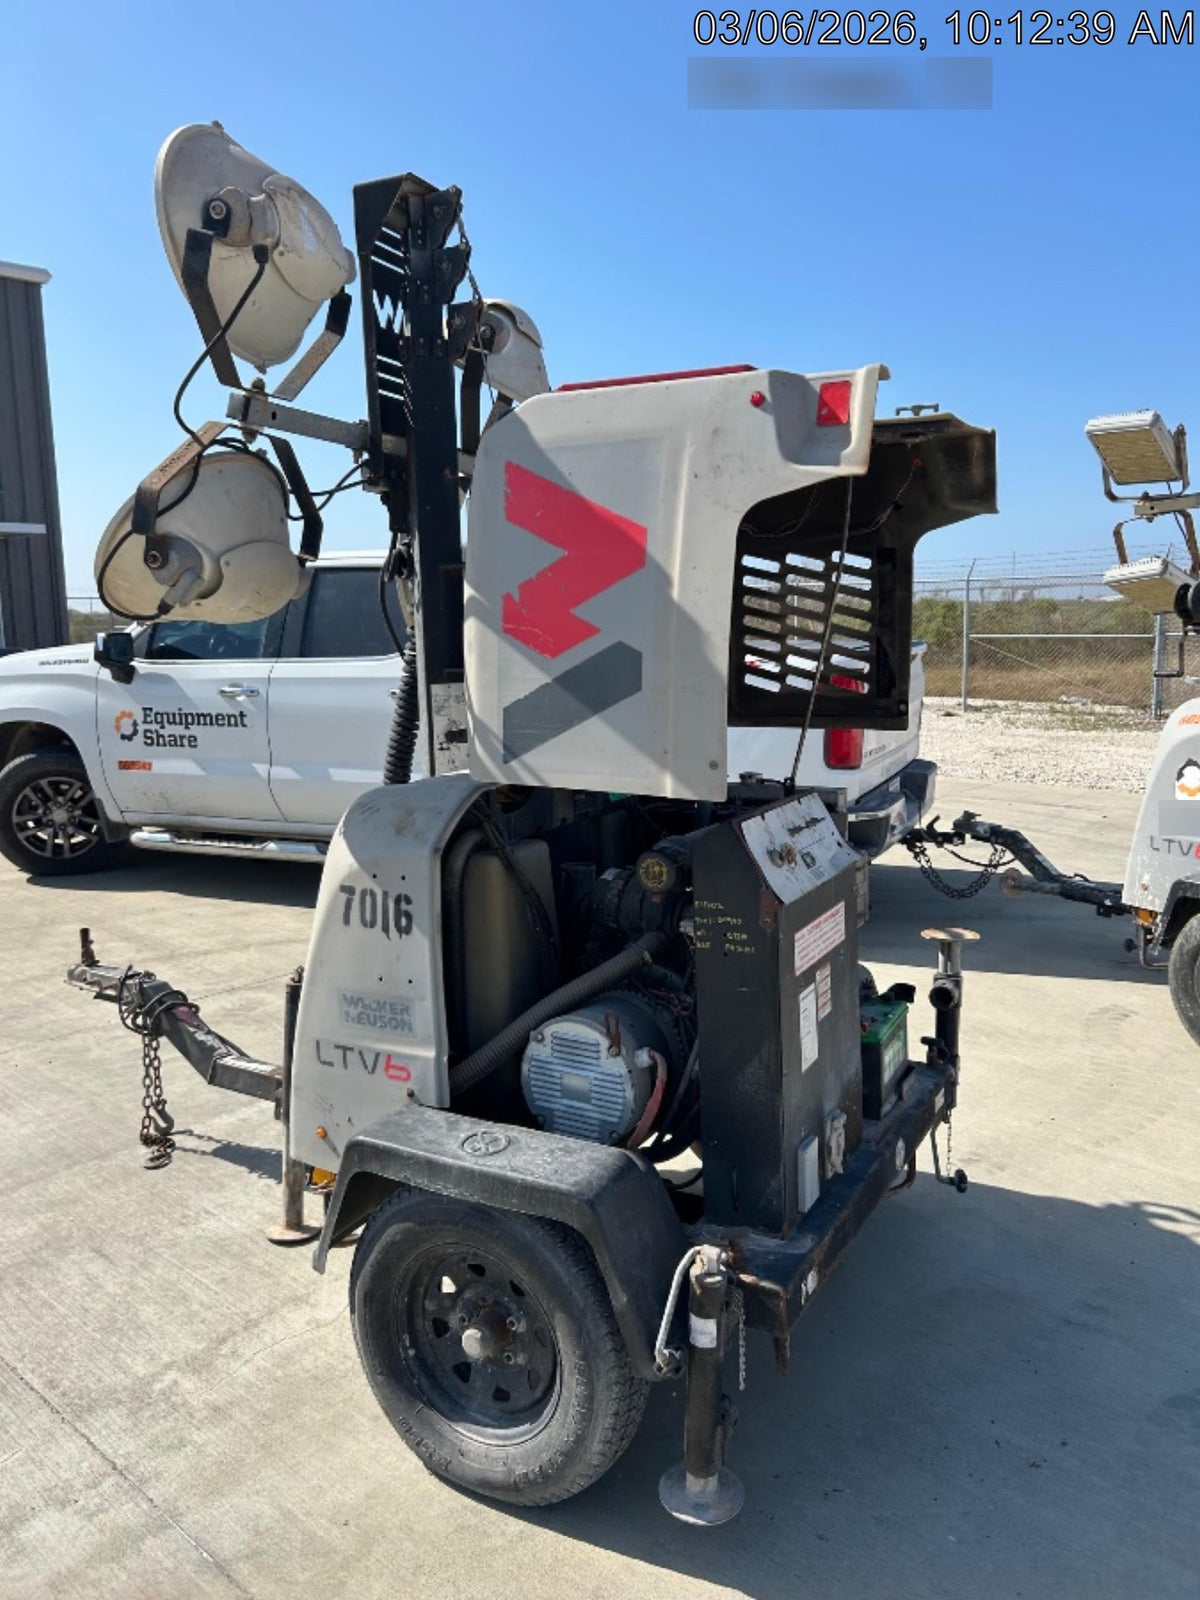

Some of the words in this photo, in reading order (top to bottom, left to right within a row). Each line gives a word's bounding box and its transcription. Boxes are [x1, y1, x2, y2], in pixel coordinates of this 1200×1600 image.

[141, 706, 248, 730] Equipment
[143, 728, 198, 748] Share
[338, 884, 413, 940] 7016
[315, 1039, 411, 1082] LTV6
